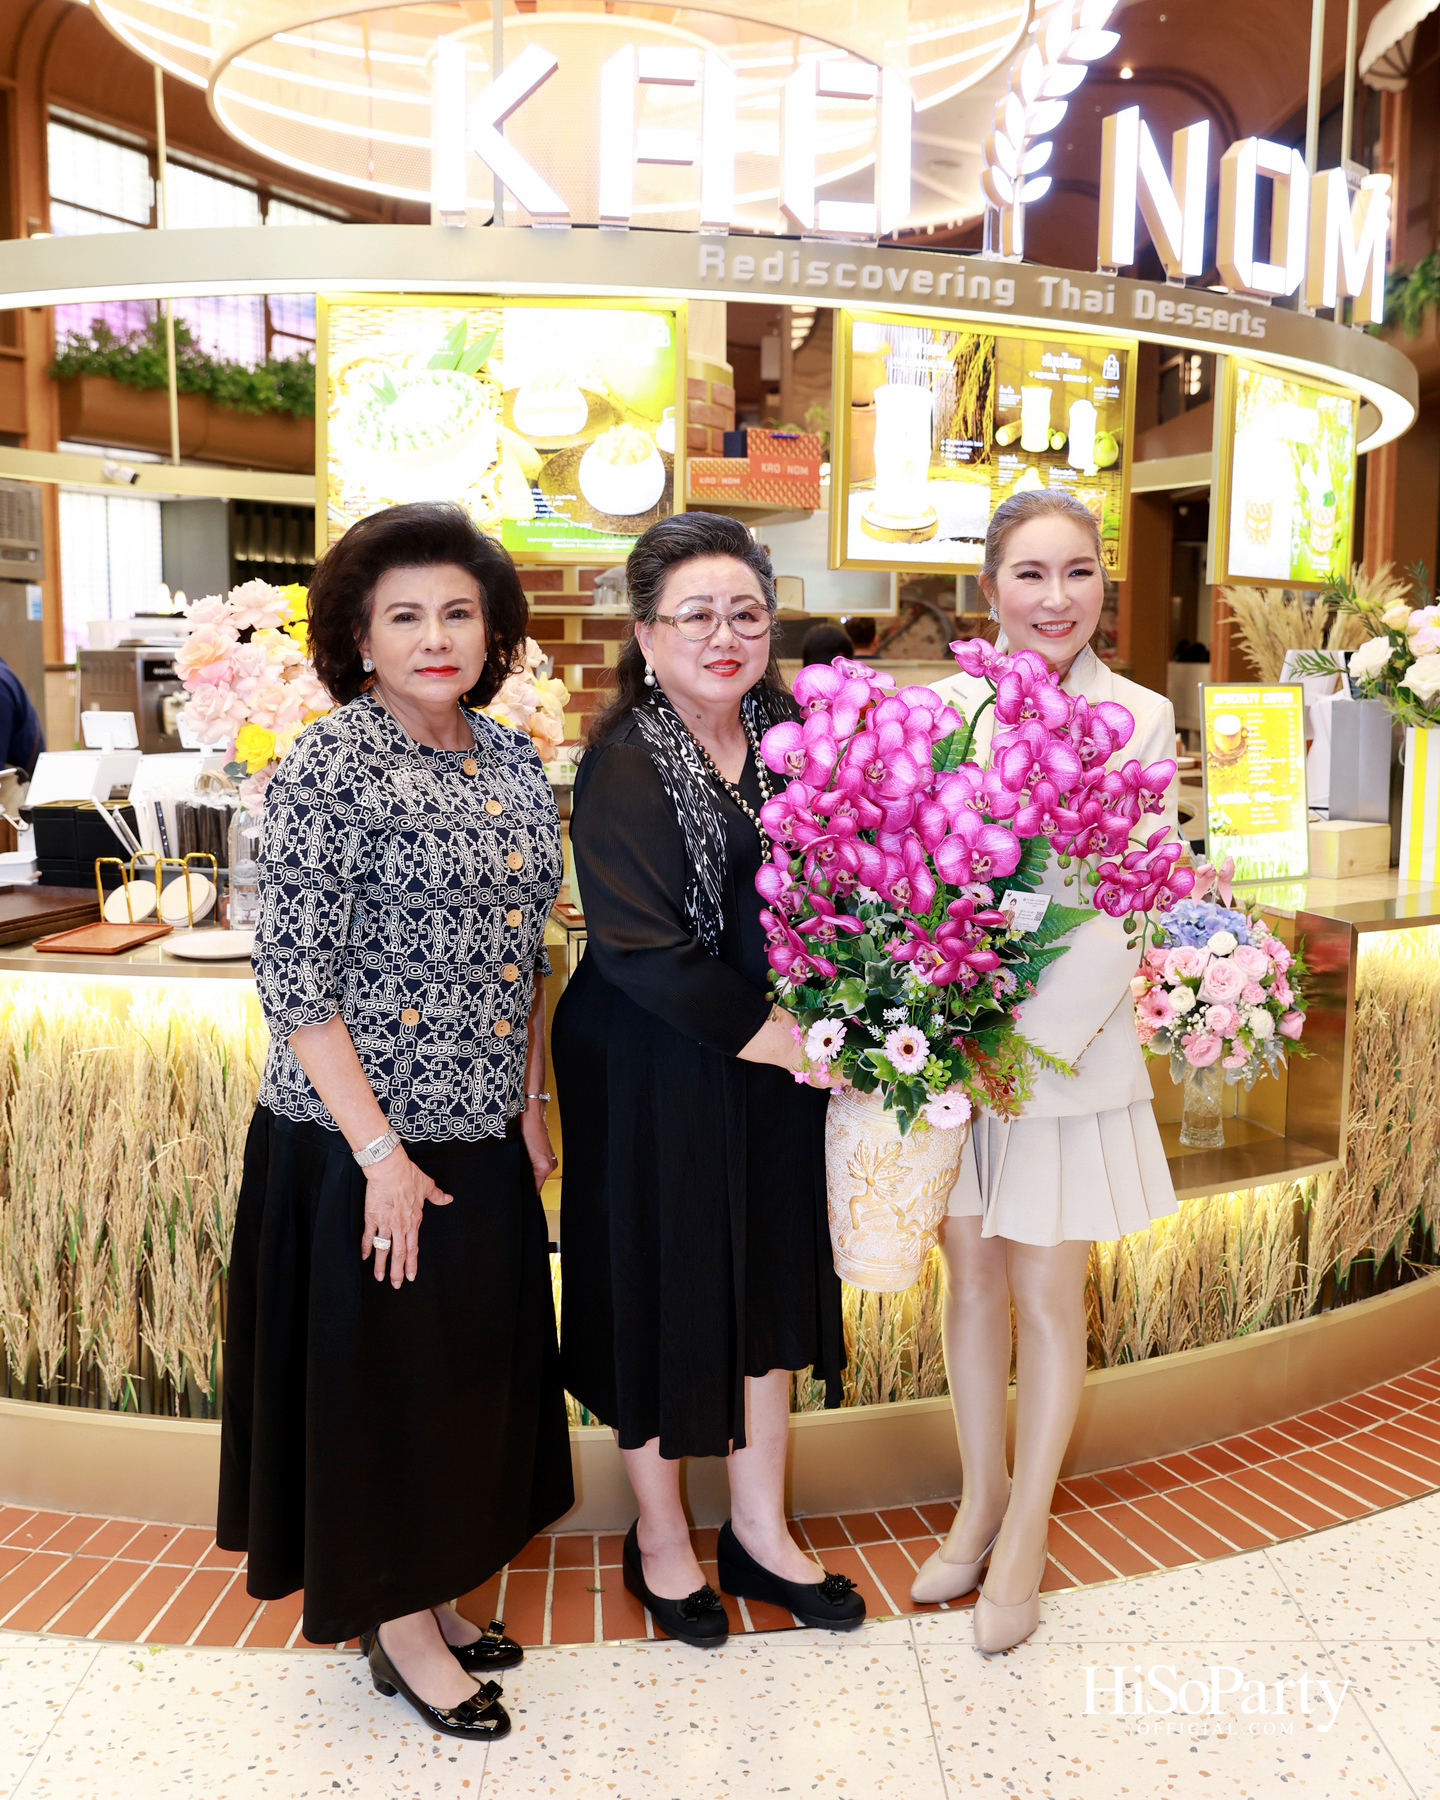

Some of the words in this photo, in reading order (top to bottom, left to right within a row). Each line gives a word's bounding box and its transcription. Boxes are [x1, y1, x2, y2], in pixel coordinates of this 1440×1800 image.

[1098, 105, 1391, 325] NOM
[700, 244, 1016, 307] Rediscovering
[1038, 275, 1116, 315] Thai
[1134, 288, 1267, 339] Desserts
[721, 476, 741, 485] NOM
[787, 464, 809, 476] NOM
